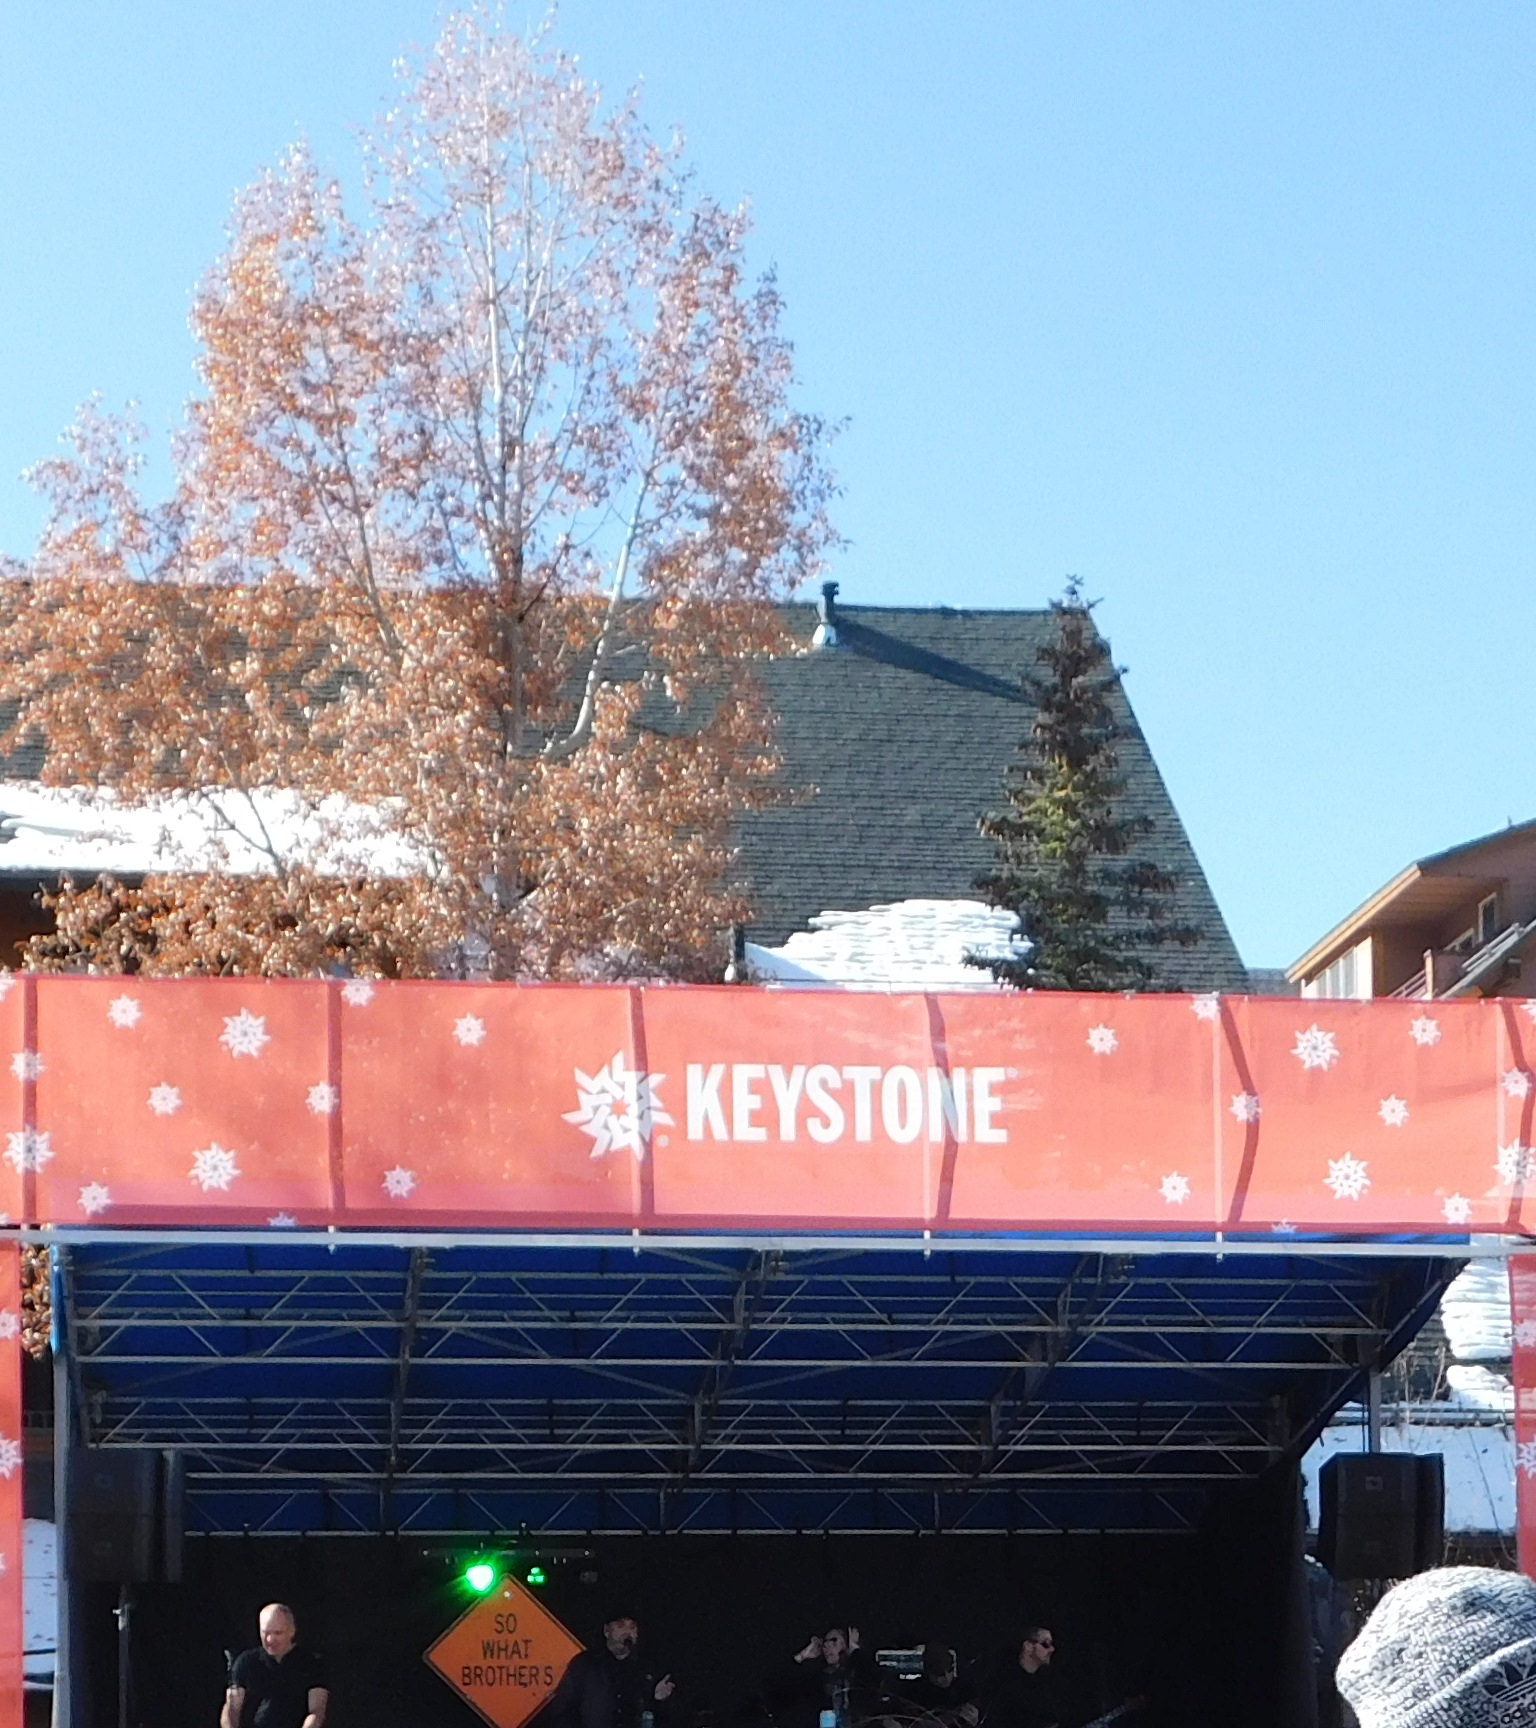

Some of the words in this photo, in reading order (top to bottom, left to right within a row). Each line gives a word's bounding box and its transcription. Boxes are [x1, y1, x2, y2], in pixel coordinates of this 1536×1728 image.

[686, 1063, 1008, 1144] KEYSTONE
[494, 1612, 518, 1635] SO
[481, 1639, 533, 1660] WHAT
[461, 1665, 554, 1688] BROTHERS
